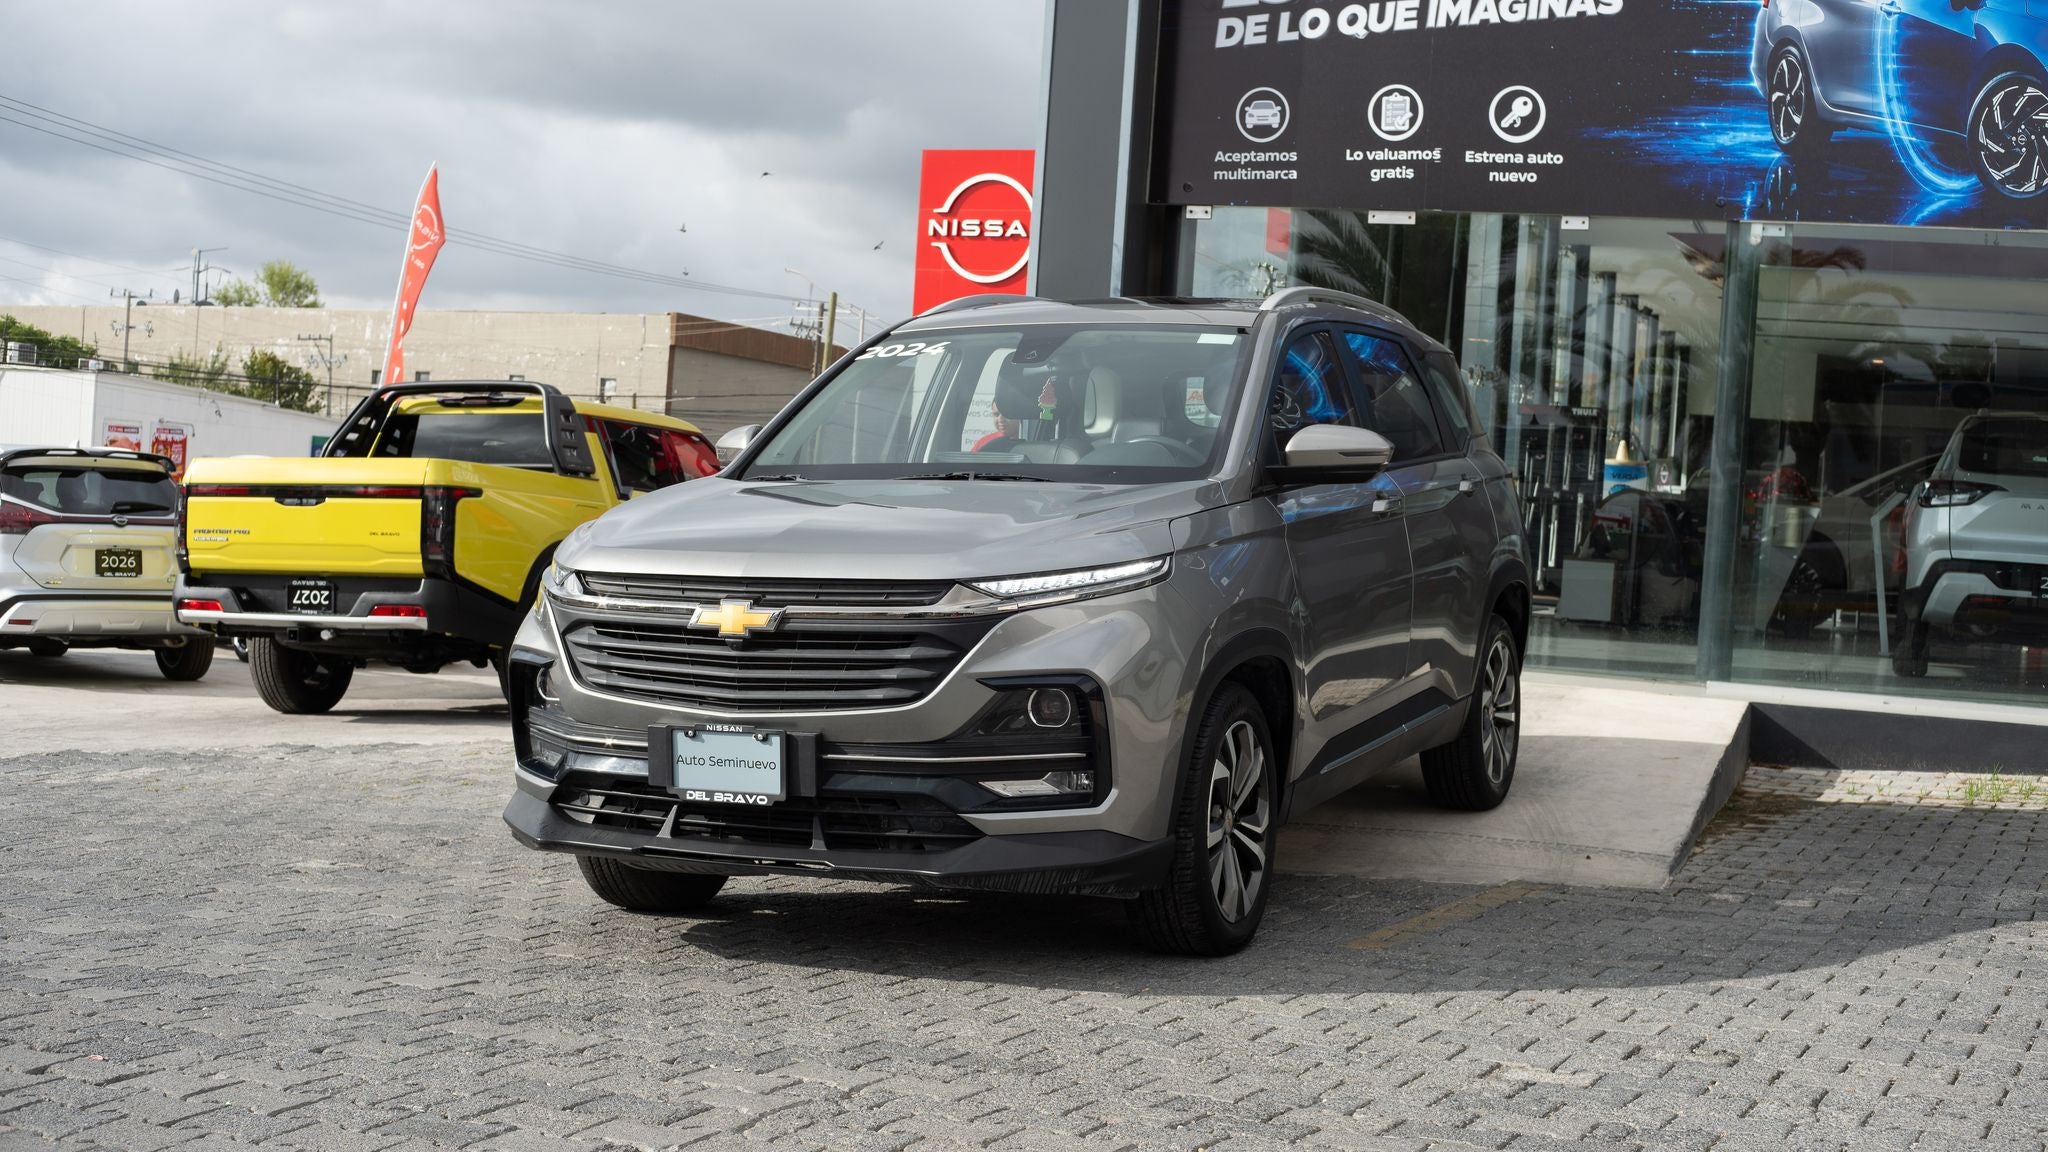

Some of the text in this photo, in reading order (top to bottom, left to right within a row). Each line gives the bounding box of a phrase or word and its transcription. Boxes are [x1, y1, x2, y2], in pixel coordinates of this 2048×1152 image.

[1215, 13, 1270, 48] DE
[1277, 7, 1331, 42] LO
[1337, 0, 1420, 39] QUE
[1214, 151, 1298, 165] Aceptamos
[1345, 147, 1442, 162] Lo valuamos
[1465, 150, 1564, 165] Estrena auto
[1213, 168, 1298, 180] multimarca
[1370, 165, 1415, 182] gratis
[1489, 170, 1538, 183] nuevo
[928, 218, 1028, 238] NISSA
[855, 341, 953, 361] 2024
[1571, 407, 1598, 416] THULE
[101, 555, 136, 568] 2026
[292, 590, 330, 605] 2027
[706, 724, 743, 733] NISSAN
[676, 755, 777, 770] Auto Seminuevo
[686, 790, 768, 805] DEL BRAVO
